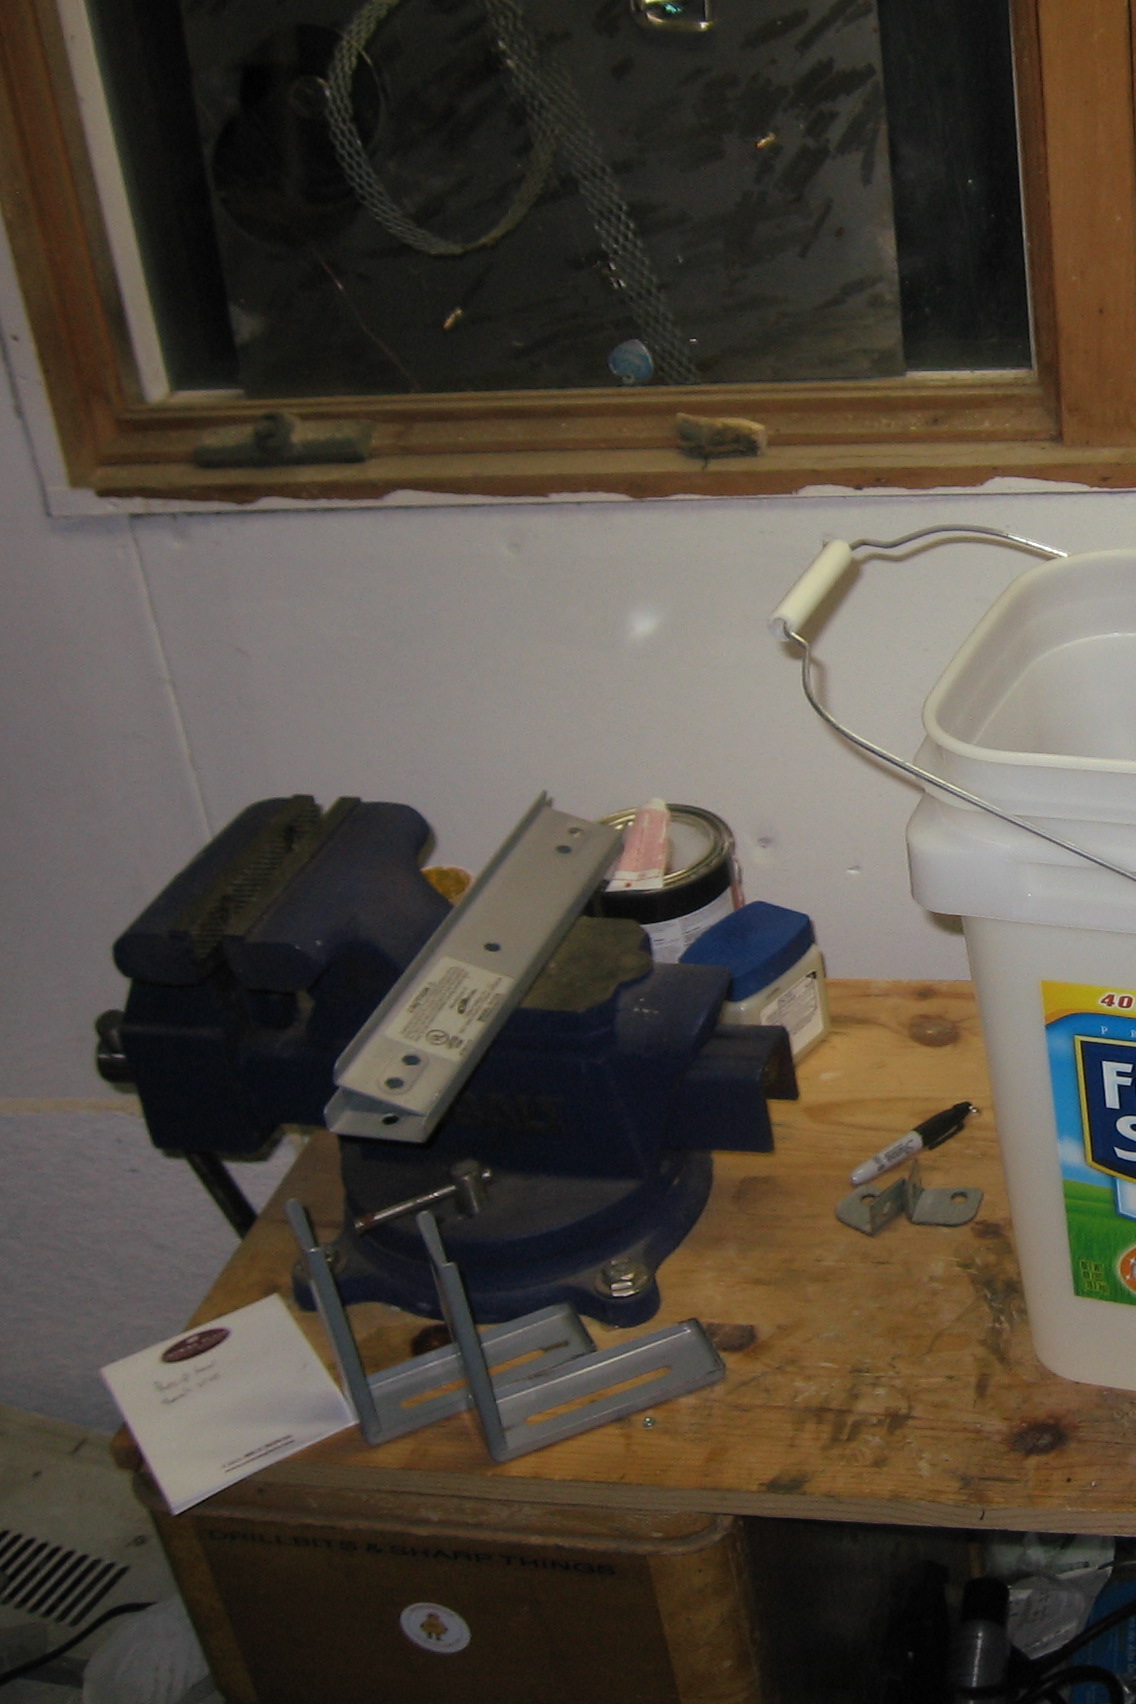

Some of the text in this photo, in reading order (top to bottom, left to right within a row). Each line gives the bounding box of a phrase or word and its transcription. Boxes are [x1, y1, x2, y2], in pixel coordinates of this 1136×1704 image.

[1100, 994, 1133, 1009] 40
[389, 1544, 494, 1563] SHARP
[497, 1553, 617, 1576] THINGS
